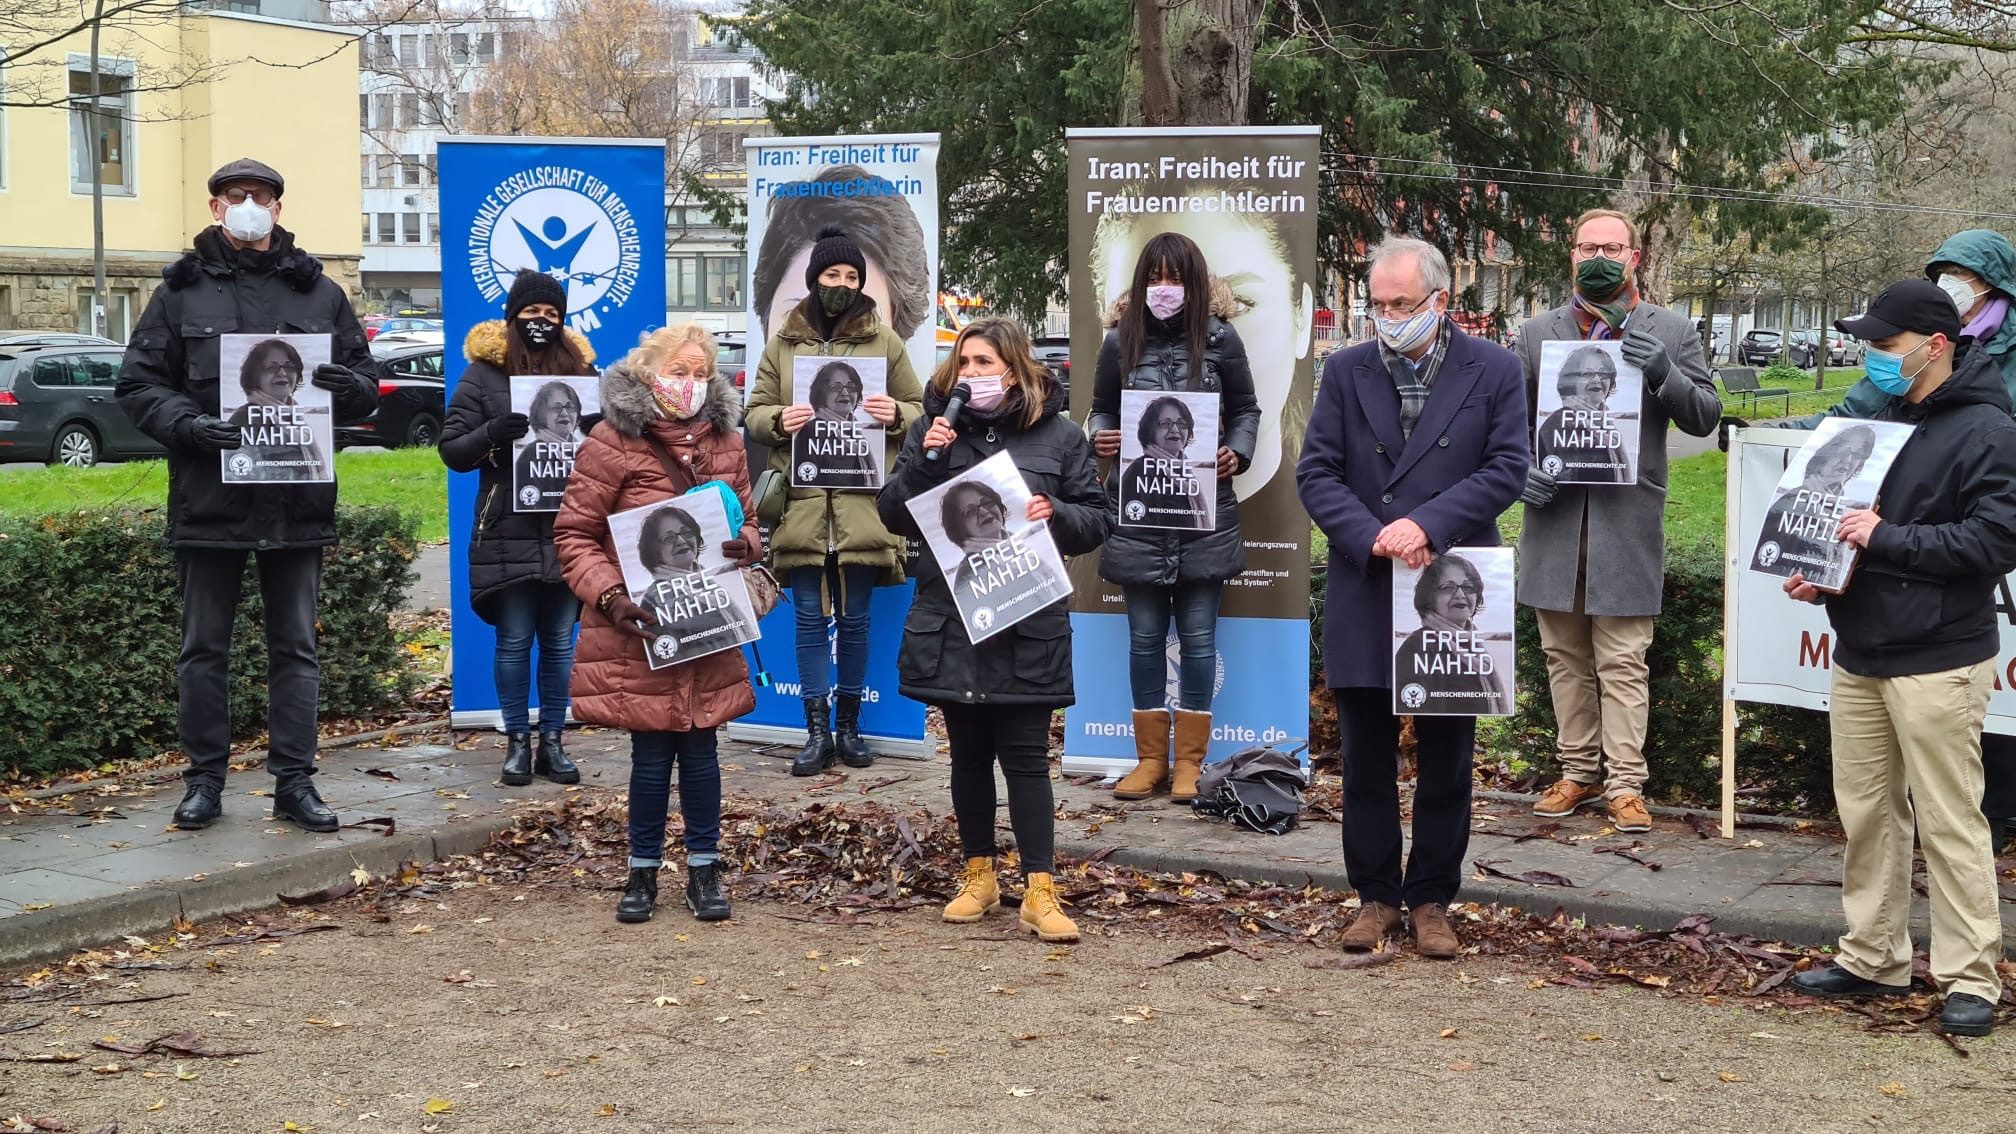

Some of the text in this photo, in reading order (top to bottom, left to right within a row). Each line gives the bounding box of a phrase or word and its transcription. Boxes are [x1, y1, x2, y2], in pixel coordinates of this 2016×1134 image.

[757, 143, 920, 166] Iran: Freiheit für
[1087, 155, 1306, 179] Iran: Freiheit für
[756, 175, 922, 200] Frauenrechtlerin
[1086, 190, 1306, 214] Frauenrechtlerin
[469, 195, 502, 303] INTERNATIONALE
[494, 166, 585, 205] GESELLSCHAFT
[601, 192, 641, 308] MENSCHENRECHTE
[247, 405, 306, 425] FREE
[1561, 409, 1616, 430] FREE
[240, 425, 313, 446] NAHID
[814, 420, 864, 439] FREE
[1553, 429, 1621, 449] NAHID
[808, 438, 869, 457] NAHID
[529, 460, 575, 479] NAH
[1143, 457, 1194, 478] FREE
[1136, 475, 1200, 496] NAHID
[1792, 489, 1849, 520] FREE
[967, 532, 1028, 577] FREE
[1242, 539, 1298, 550] leierungszwang
[656, 569, 718, 603] FREE
[969, 549, 1040, 600] NAHID
[655, 588, 730, 627] NAHID
[1422, 630, 1486, 653] FREE
[1414, 653, 1494, 676] NAHID
[1084, 722, 1287, 743] menschte.de
